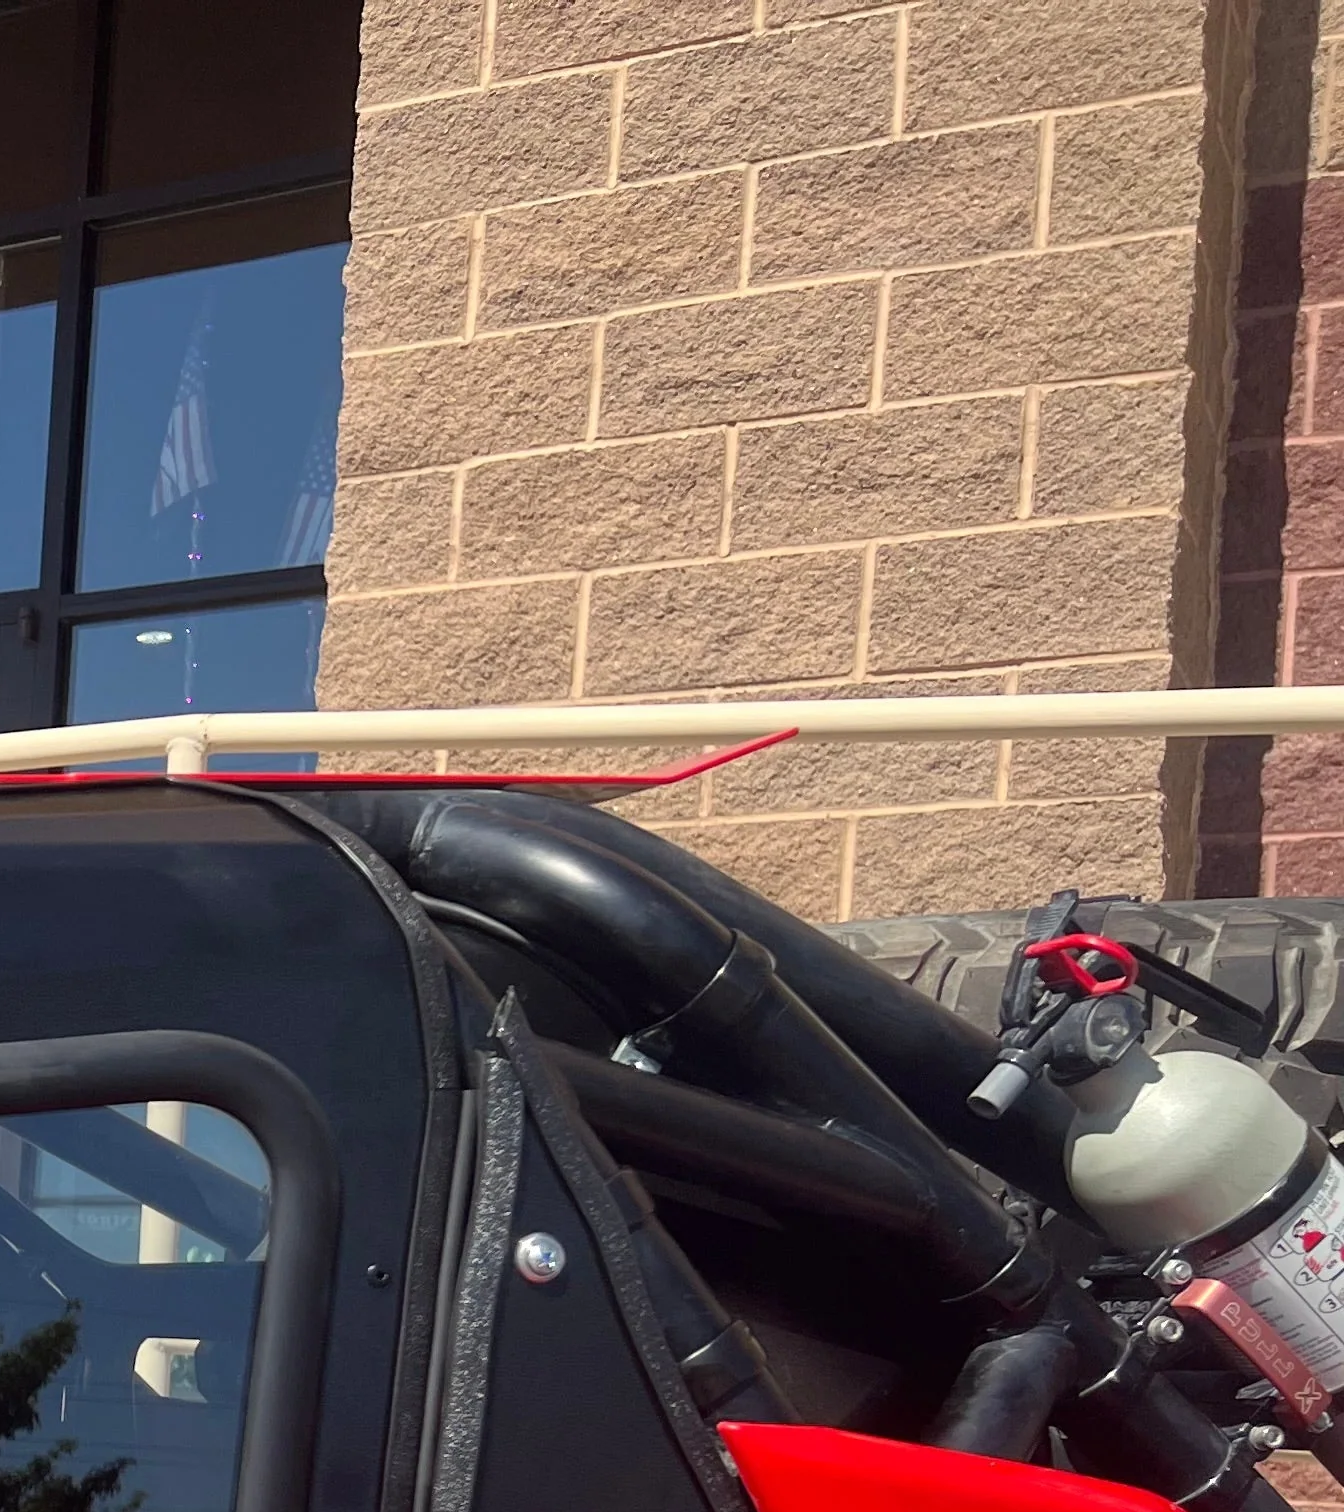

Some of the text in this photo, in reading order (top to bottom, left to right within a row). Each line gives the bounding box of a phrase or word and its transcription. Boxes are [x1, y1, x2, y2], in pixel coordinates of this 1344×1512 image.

[1301, 1271, 1313, 1283] 2
[1325, 1298, 1338, 1310] 3
[1220, 1302, 1295, 1378] PULL
